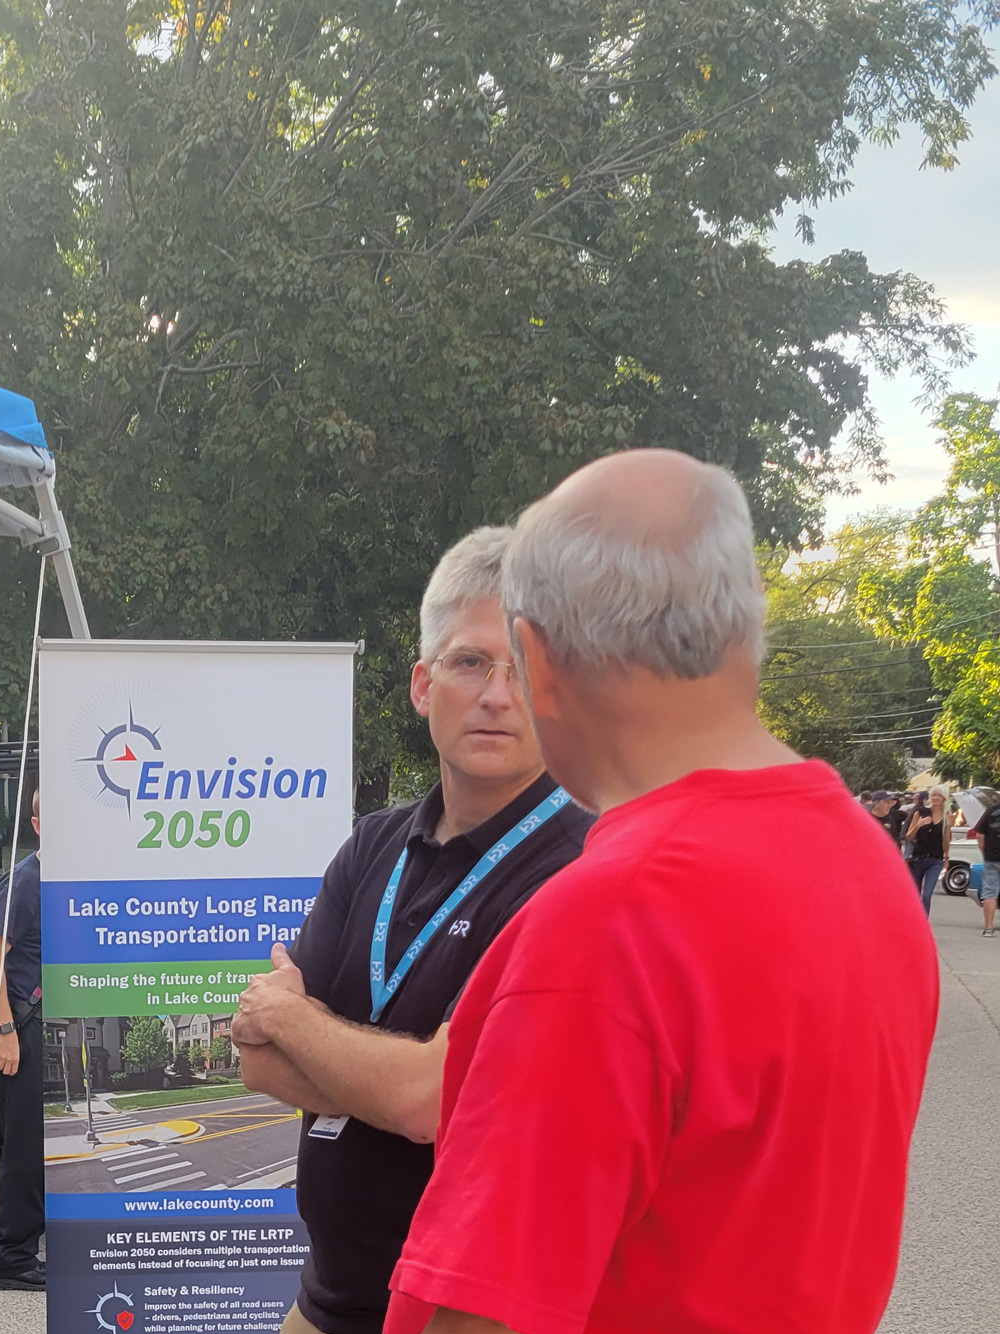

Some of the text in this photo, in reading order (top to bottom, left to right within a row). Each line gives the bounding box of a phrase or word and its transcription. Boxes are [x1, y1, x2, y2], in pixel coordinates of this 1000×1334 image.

[136, 756, 327, 800] Envision
[137, 809, 251, 849] 2050
[519, 815, 541, 834] HDR
[487, 843, 510, 863] HDR
[459, 875, 478, 895] HDR
[68, 894, 317, 919] Lake County Long Rang
[95, 923, 301, 948] Transportation Plan
[448, 920, 471, 938] HDR
[69, 974, 130, 989] Shaping
[132, 973, 157, 987] the
[160, 971, 204, 986] future
[207, 971, 222, 985] of
[147, 991, 243, 1005] in Lake Coun
[125, 1197, 274, 1212] www.lakecounty.com
[107, 1228, 294, 1244] KEY ELEMENTS OF THE LRTP
[90, 1244, 310, 1258] Envision 2050 considers multiple transportation
[93, 1261, 136, 1270] elements
[138, 1259, 172, 1269] instead
[174, 1259, 183, 1268] of
[185, 1258, 225, 1269] focusing
[227, 1259, 239, 1267] on
[240, 1257, 259, 1268] just
[280, 1257, 305, 1266] issue
[144, 1285, 245, 1298] Safety & Resiliency
[144, 1300, 284, 1311] Improve the safety of all road users
[152, 1313, 182, 1321] drivers,
[183, 1312, 231, 1321] pedestrians
[232, 1312, 248, 1320] and
[249, 1311, 280, 1320] cyclists
[144, 1321, 283, 1333] while planning for future challenge
